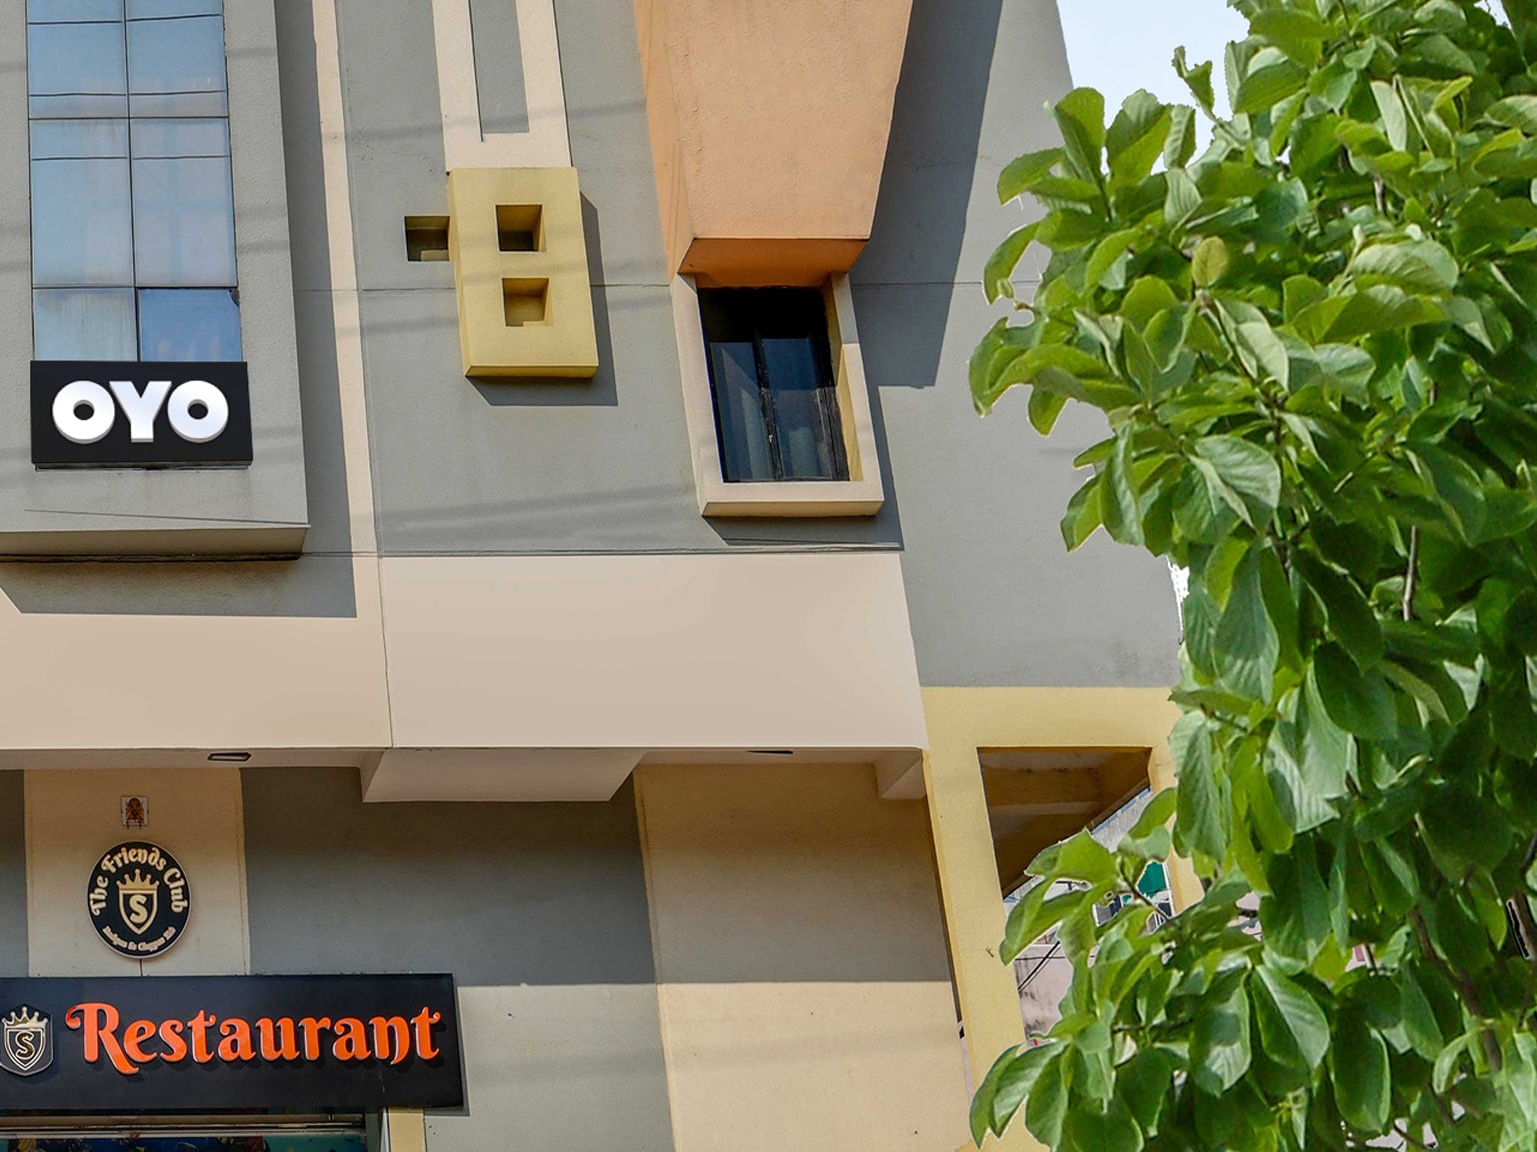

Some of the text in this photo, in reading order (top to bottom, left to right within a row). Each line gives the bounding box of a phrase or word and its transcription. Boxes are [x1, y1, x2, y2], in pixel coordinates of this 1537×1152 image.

[51, 379, 229, 445] OYO
[89, 846, 188, 916] The Friends Club
[129, 894, 148, 924] S
[15, 1030, 36, 1060] S
[64, 1001, 441, 1076] Restaurant
